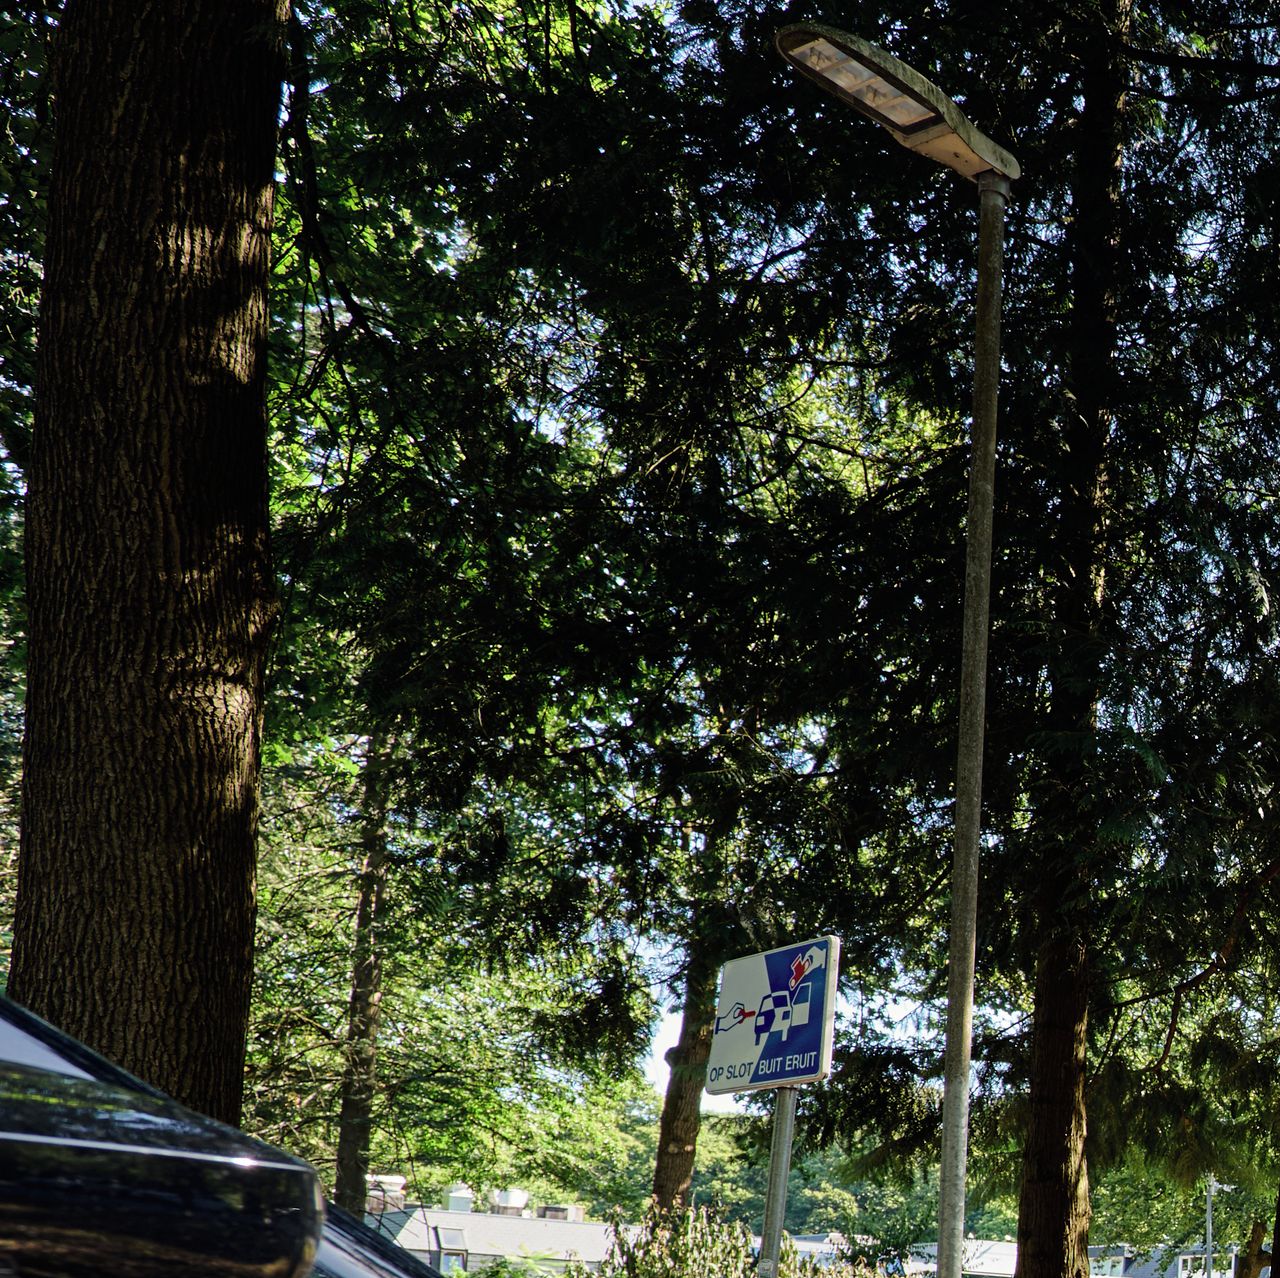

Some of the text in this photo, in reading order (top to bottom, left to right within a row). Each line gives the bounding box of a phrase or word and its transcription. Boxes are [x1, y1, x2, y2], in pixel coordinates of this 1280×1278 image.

[709, 1062, 754, 1082] OP SLOT
[758, 1051, 817, 1075] BUIT ERUIT
